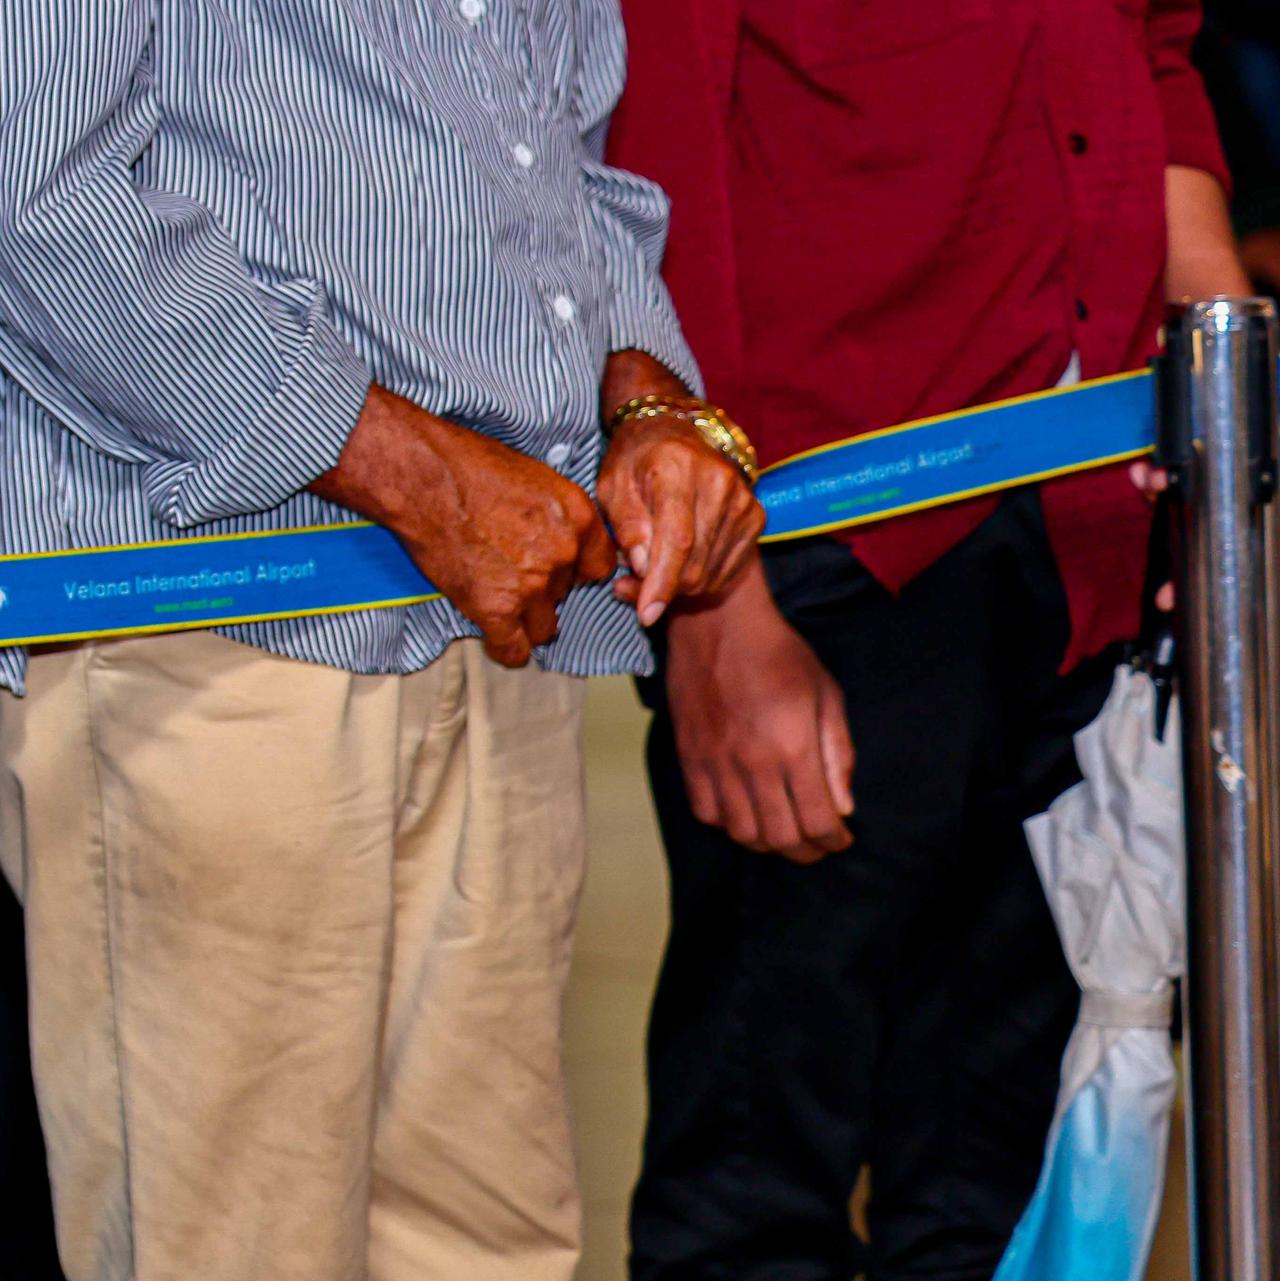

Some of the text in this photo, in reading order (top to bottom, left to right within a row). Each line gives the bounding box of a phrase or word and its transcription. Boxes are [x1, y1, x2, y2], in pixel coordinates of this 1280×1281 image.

[63, 558, 317, 600] Velana International Airport
